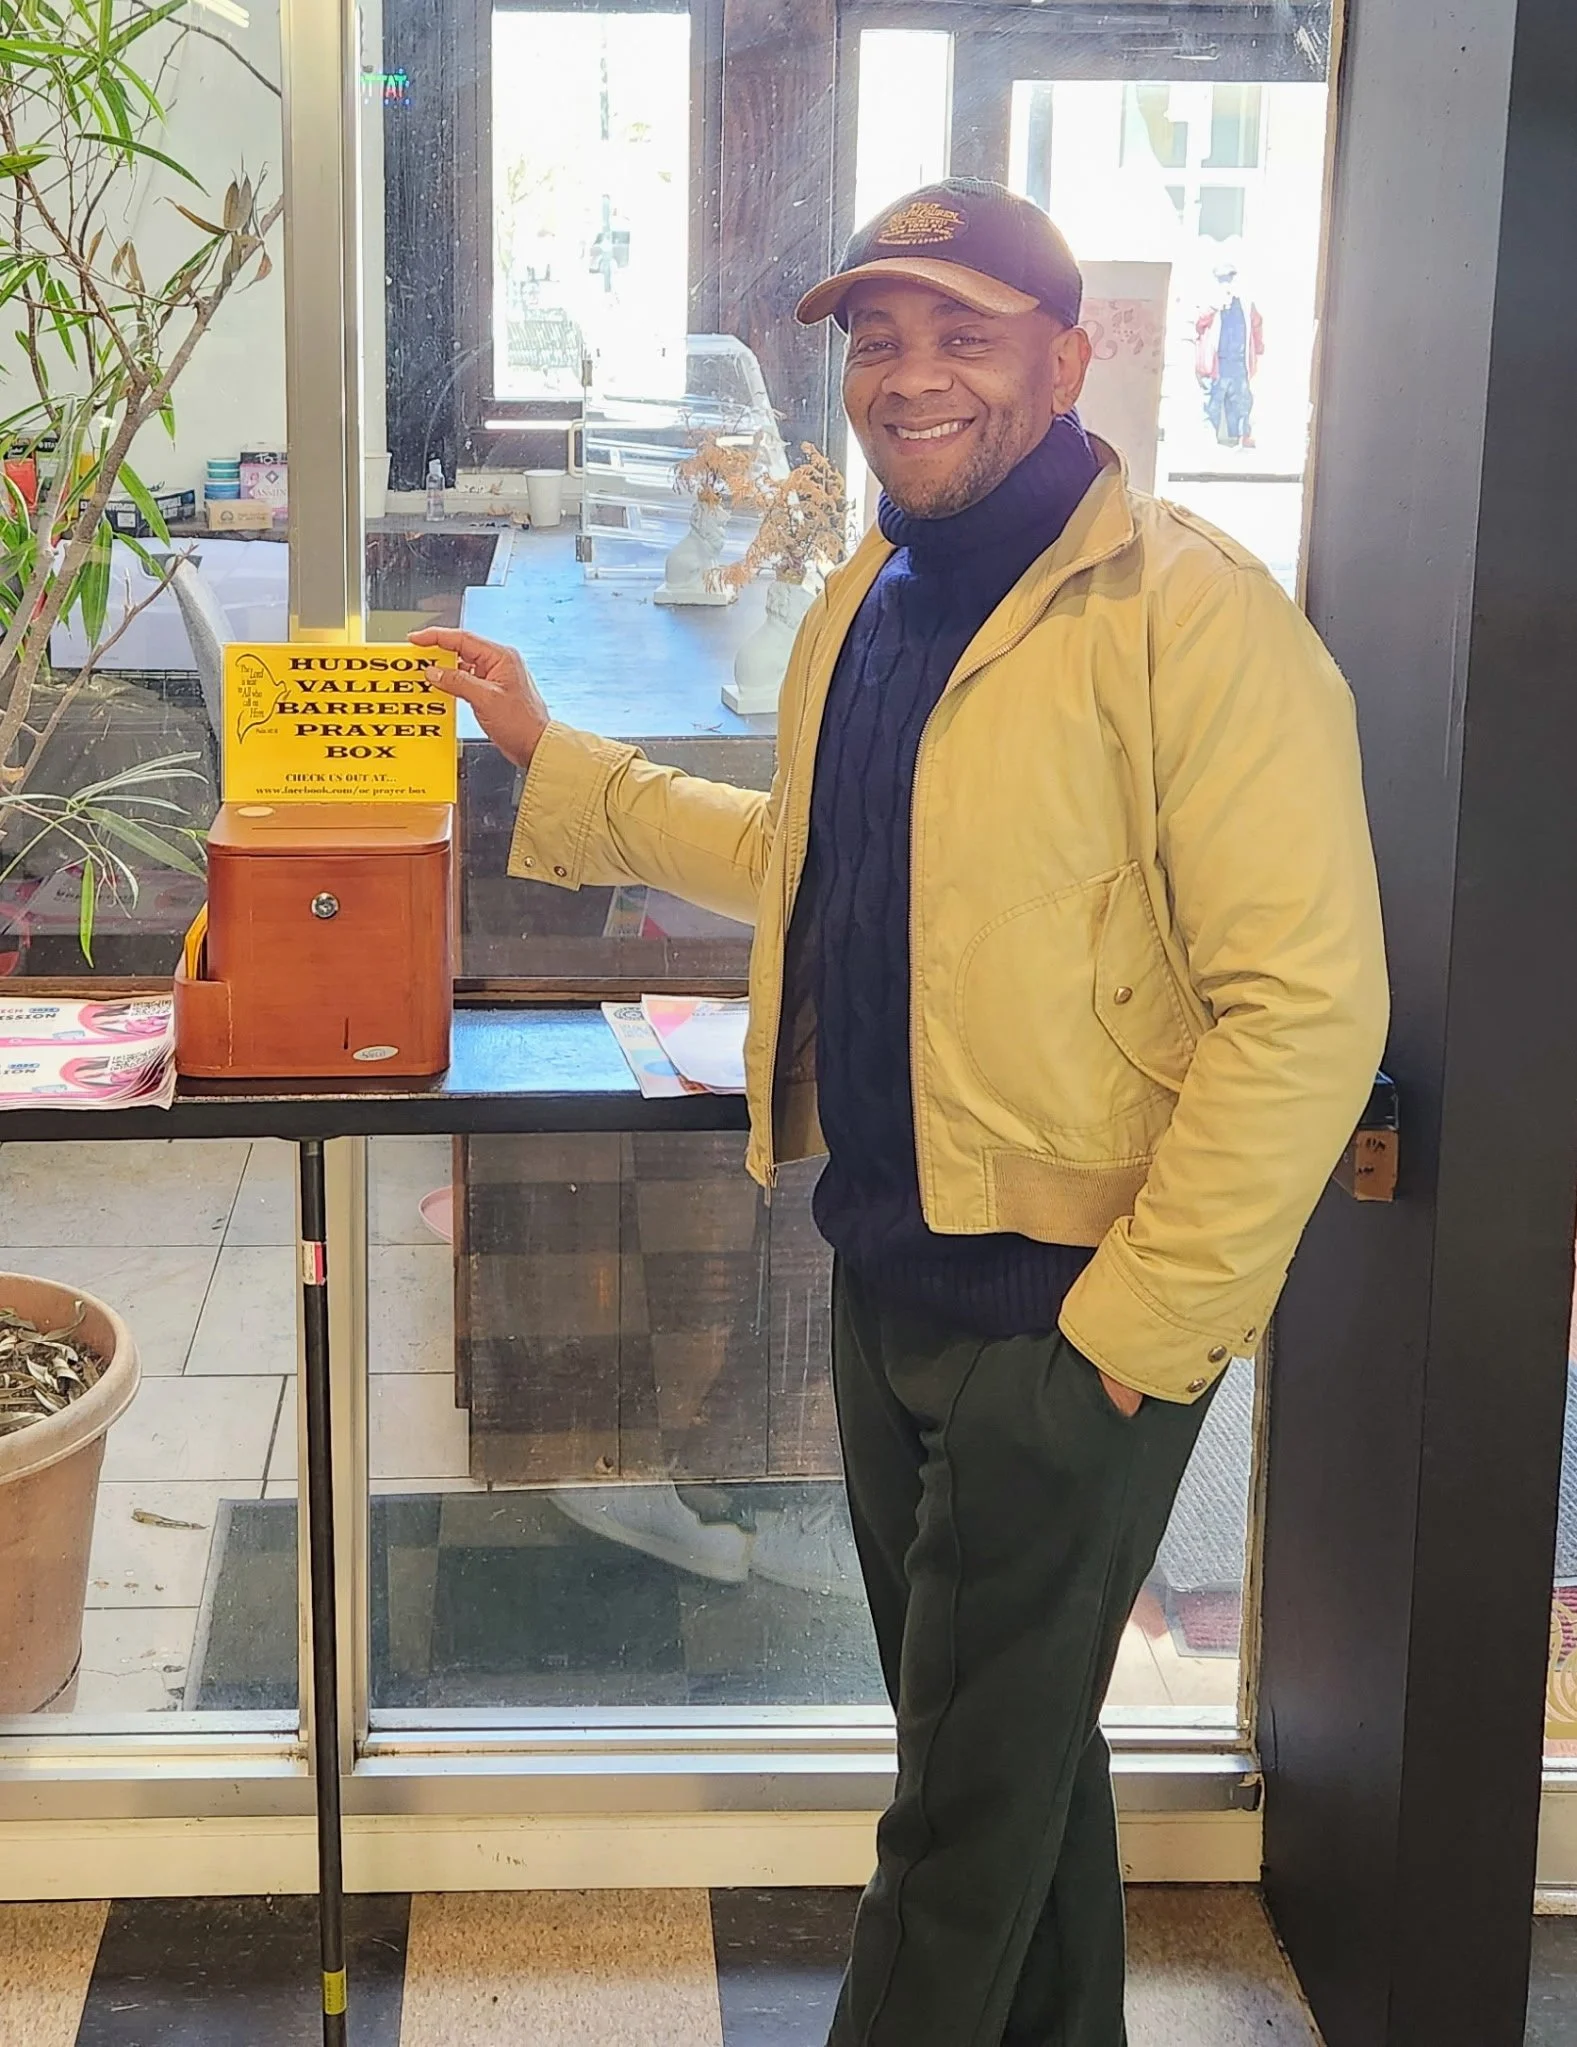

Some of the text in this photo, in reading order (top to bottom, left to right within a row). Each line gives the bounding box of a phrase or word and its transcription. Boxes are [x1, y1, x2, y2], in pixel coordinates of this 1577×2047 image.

[288, 657, 438, 672] HUDSON
[294, 679, 434, 694] VALLEY
[276, 702, 447, 716] BARBERS
[295, 723, 442, 738] PRAYER
[324, 746, 397, 759] BOX
[285, 773, 325, 783] CHECK
[328, 774, 343, 783] US
[345, 774, 369, 783] OUT
[372, 788, 406, 797] prayer
[408, 786, 426, 794] box
